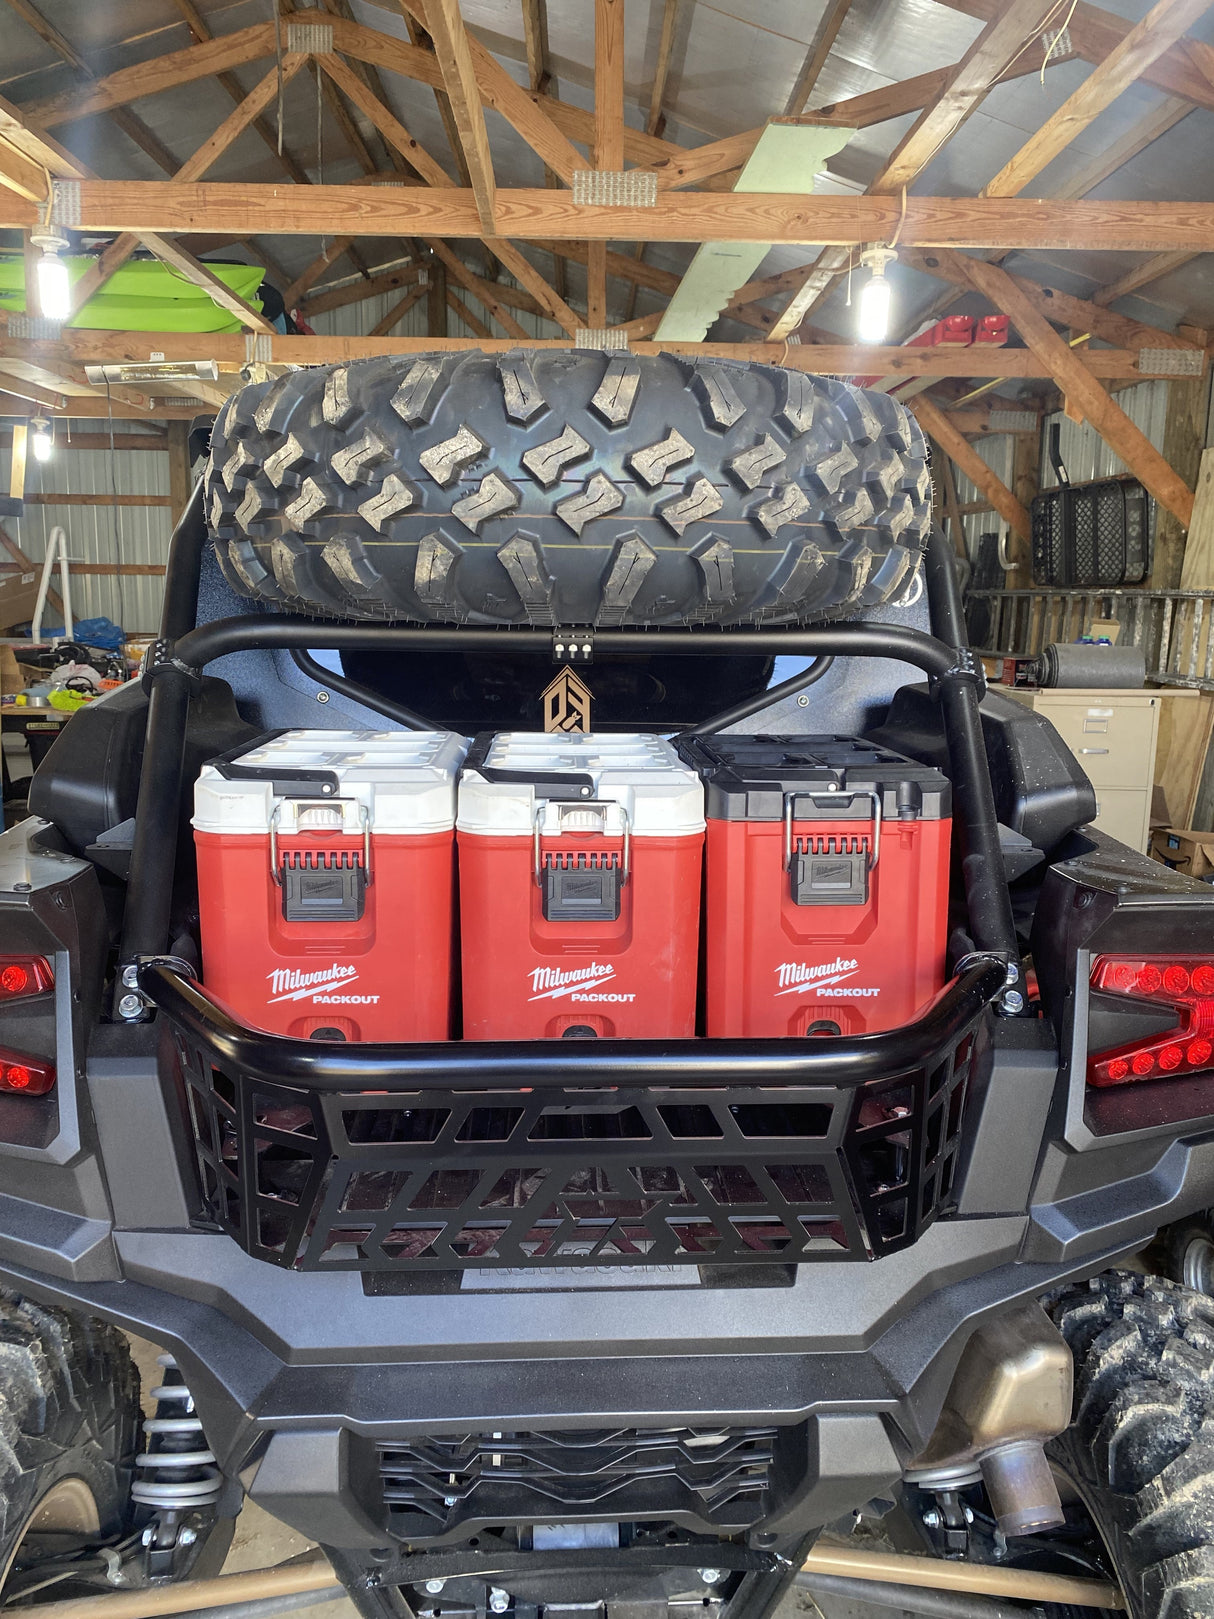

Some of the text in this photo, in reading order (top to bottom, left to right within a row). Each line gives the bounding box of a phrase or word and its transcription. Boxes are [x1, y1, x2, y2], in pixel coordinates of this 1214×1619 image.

[265, 963, 357, 995] Milwaukee
[527, 961, 615, 993] Milwaukee
[774, 956, 859, 988] Milwaukee
[312, 995, 380, 1004] PACKOUT
[571, 993, 636, 1002] PACKOUT
[816, 988, 880, 997] PACKOUT
